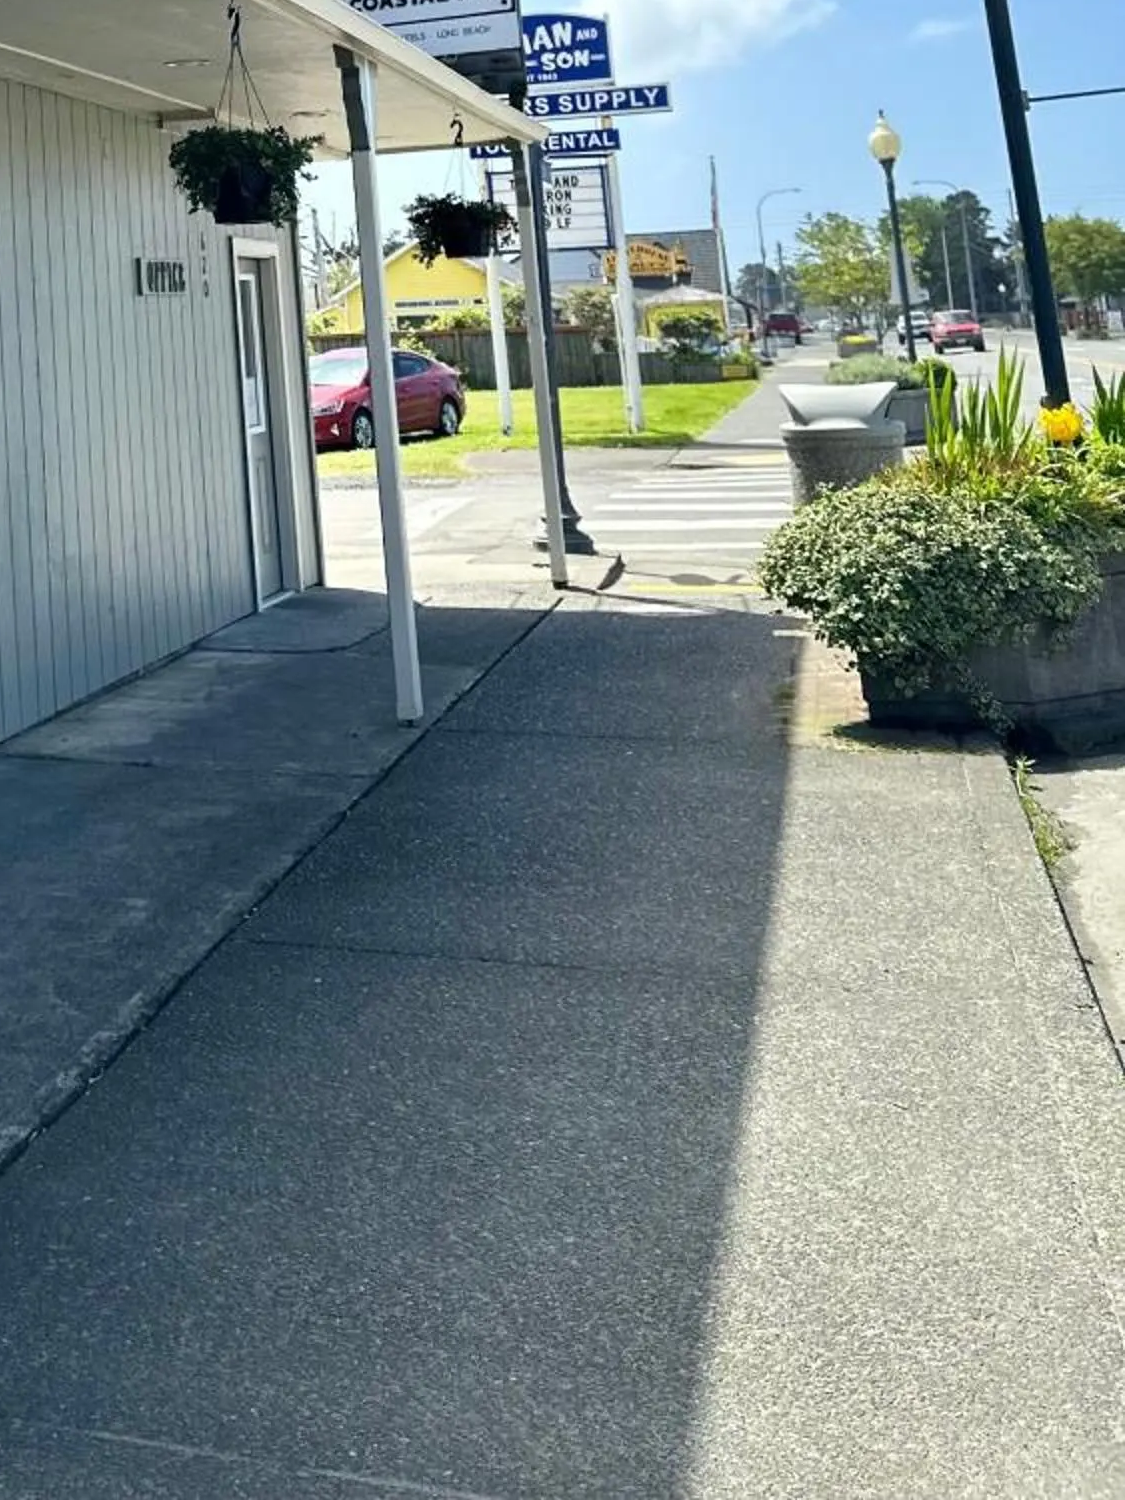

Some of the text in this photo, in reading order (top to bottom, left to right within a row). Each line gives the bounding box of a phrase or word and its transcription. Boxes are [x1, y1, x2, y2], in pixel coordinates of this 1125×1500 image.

[436, 28, 459, 38] LONG
[462, 24, 492, 36] BEACH
[576, 27, 598, 41] AND
[540, 48, 590, 71] SON
[558, 87, 658, 112] SUPPLY
[554, 175, 579, 188] AND
[146, 261, 186, 293] OFFICE
